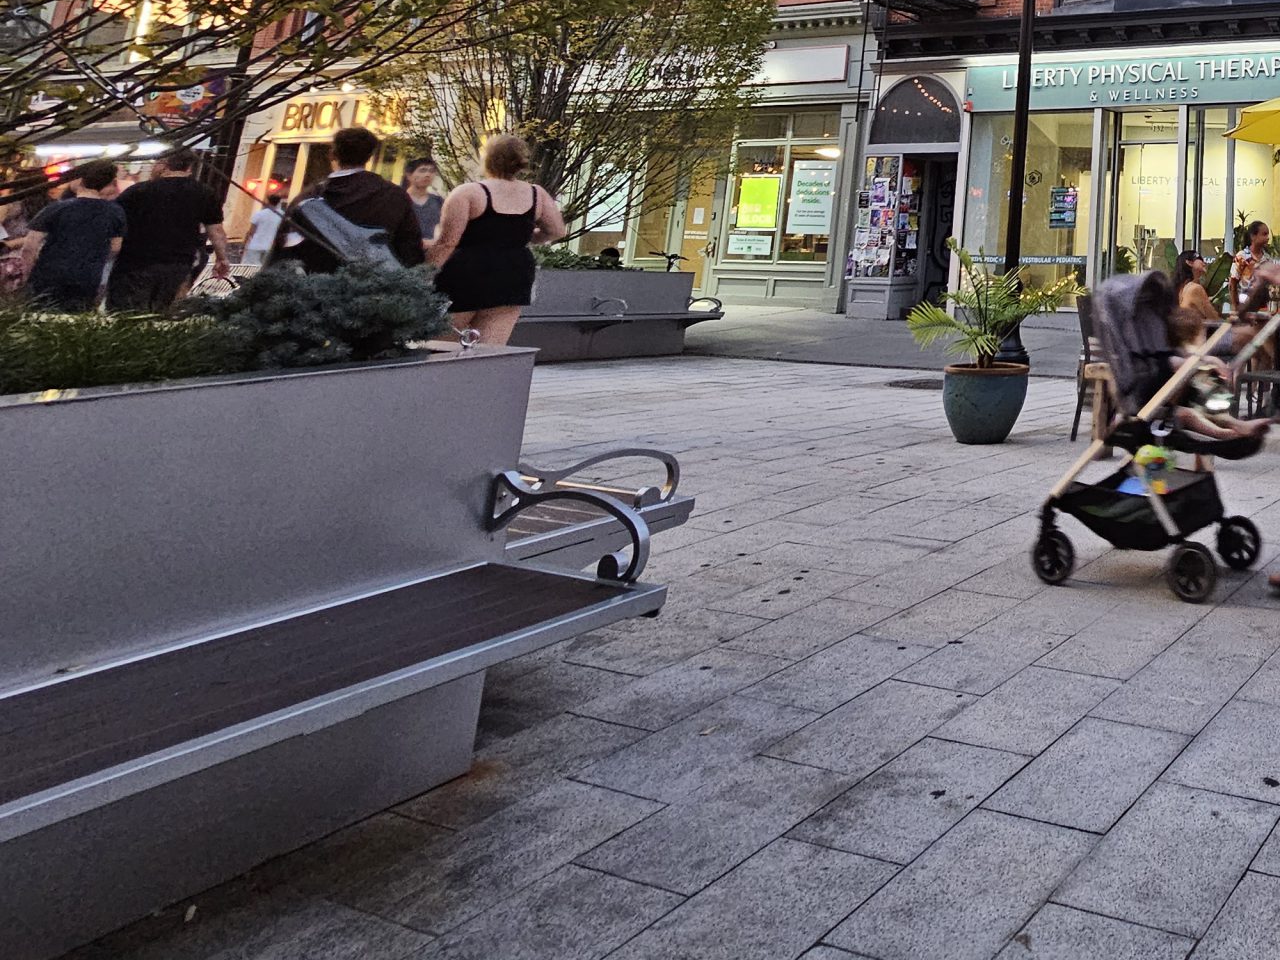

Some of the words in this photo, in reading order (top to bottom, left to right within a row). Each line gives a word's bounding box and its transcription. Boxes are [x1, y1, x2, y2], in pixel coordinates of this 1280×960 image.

[1002, 67, 1082, 89] LIERTY
[1088, 61, 1189, 85] PHYSICAL
[1090, 90, 1099, 102] &
[1109, 87, 1199, 101] WELLNESS
[282, 100, 348, 131] BRICK
[1131, 176, 1171, 185] LIBERTY
